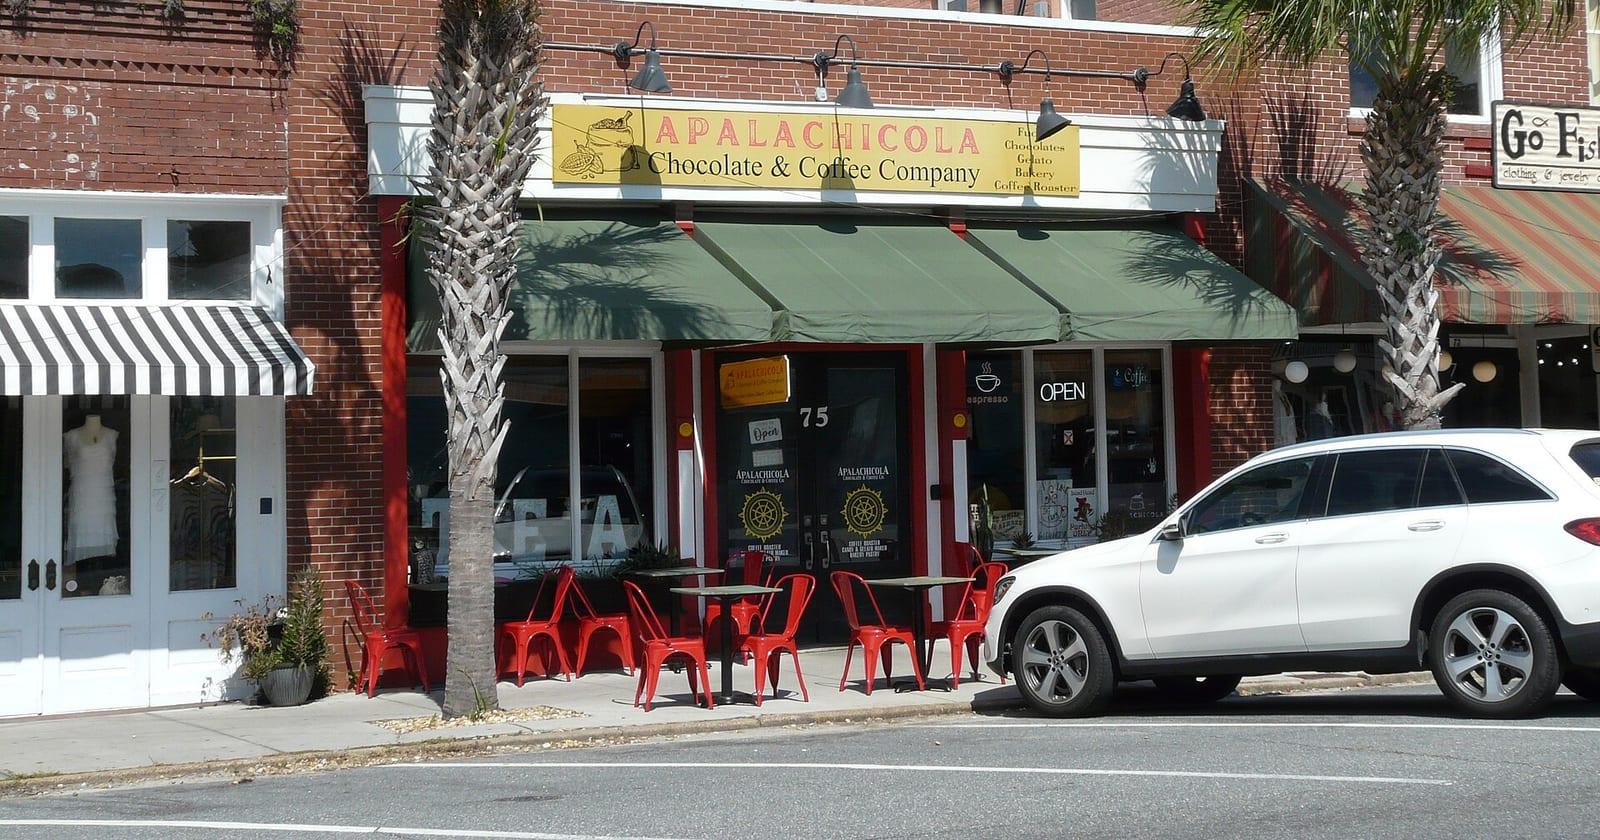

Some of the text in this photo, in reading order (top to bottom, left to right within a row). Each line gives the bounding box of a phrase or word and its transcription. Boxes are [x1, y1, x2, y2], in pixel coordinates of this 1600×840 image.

[656, 116, 980, 154] APALACHICOLA
[1501, 109, 1600, 162] Go Fis
[1005, 140, 1065, 152] Chocolates
[1017, 153, 1053, 165] Gelato
[649, 152, 980, 188] Chocolate & Coffee Company
[1015, 167, 1055, 181] Bakery
[1503, 167, 1537, 184] clothing
[994, 180, 1077, 193] Coffee Roaster
[1040, 381, 1086, 402] OPEN
[966, 395, 1009, 405] espresso
[800, 406, 829, 428] 75
[753, 427, 779, 442] Open
[736, 468, 790, 479] APALACHICOLA
[838, 465, 889, 477] APALACHICOLA
[421, 495, 630, 566] TEA
